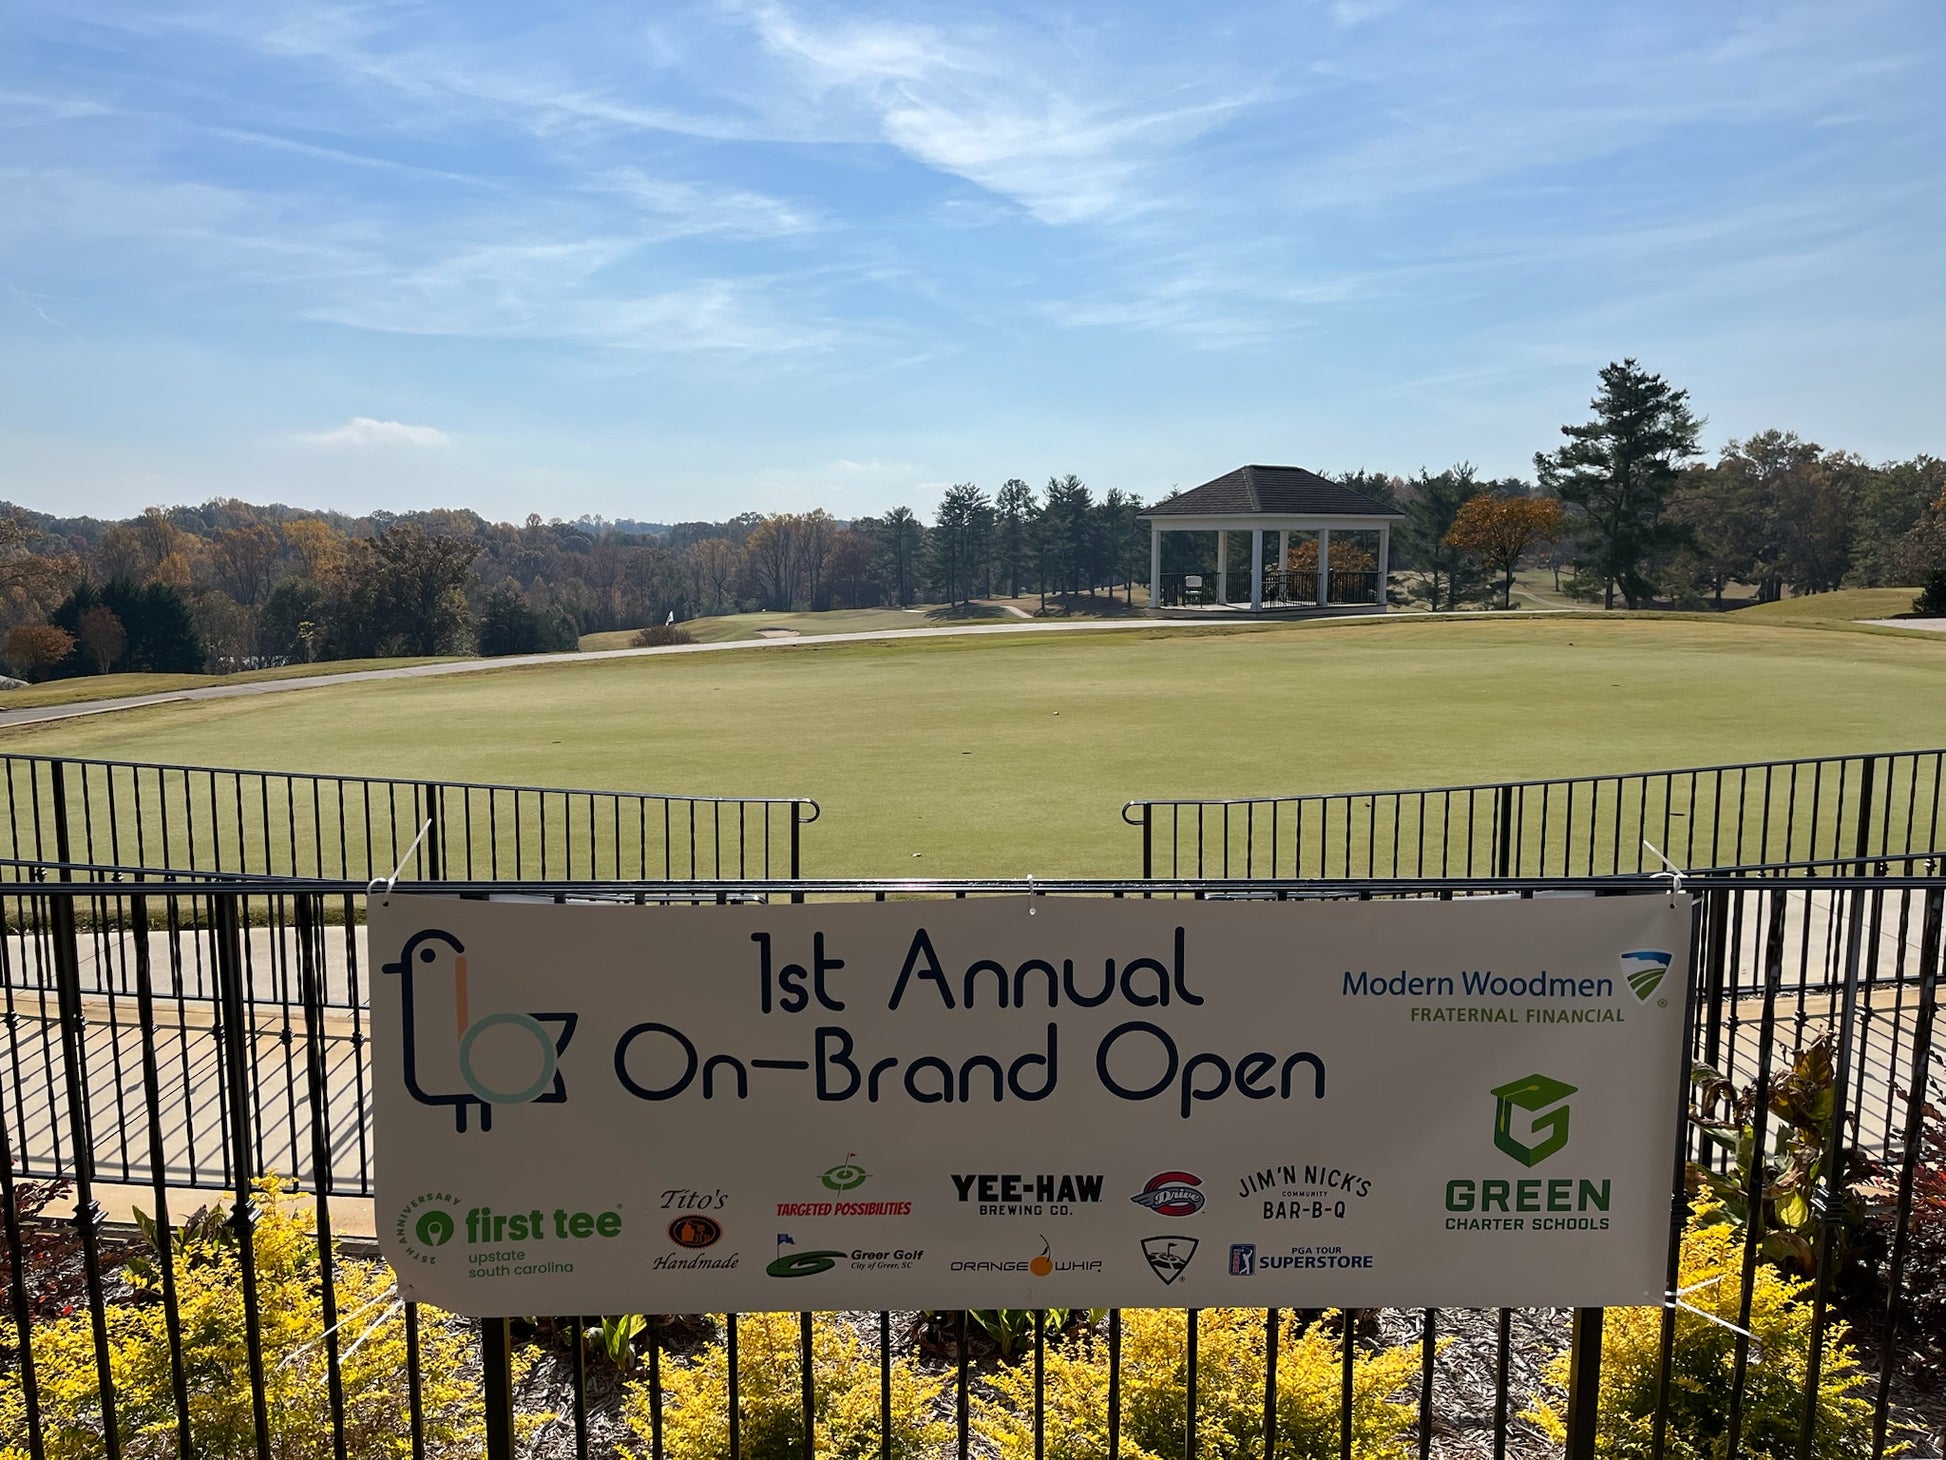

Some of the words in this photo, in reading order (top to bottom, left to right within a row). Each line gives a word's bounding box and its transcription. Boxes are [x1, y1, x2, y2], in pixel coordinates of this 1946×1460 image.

[751, 929, 847, 1015] 1st
[888, 924, 1206, 1011] Annual
[1342, 970, 1454, 997] Modern
[1462, 970, 1614, 998] Woodmen
[1410, 1007, 1519, 1024] FRATERNAL
[1525, 1008, 1626, 1024] FINANCIAL
[1096, 1020, 1327, 1120] Open
[950, 1174, 1103, 1203] YEE-HAW
[1304, 1164, 1373, 1198] NICK'S
[659, 1188, 730, 1210] Tito's
[1154, 1187, 1200, 1207] Drive
[1281, 1190, 1329, 1198] COMMUNITY
[1444, 1179, 1611, 1213] GREEN
[396, 1192, 461, 1244] ANNIVERSARY
[776, 1202, 833, 1217] TARGETED
[834, 1201, 912, 1216] POSSIBILITIES
[979, 1205, 1043, 1216] BREWING
[1049, 1204, 1074, 1216] CO.
[1263, 1201, 1346, 1219] BAR-B-Q
[464, 1205, 545, 1244] first
[552, 1207, 623, 1240] tee
[1445, 1217, 1525, 1231] CHARTER
[1531, 1217, 1610, 1231] SCHOOLS
[468, 1248, 526, 1265] upstate
[651, 1251, 740, 1271] Handmade
[851, 1249, 890, 1260] Greer
[893, 1249, 924, 1260] Golf
[1259, 1256, 1373, 1268] SUPERSTORE
[468, 1264, 510, 1278] south
[513, 1261, 574, 1277] carolina
[851, 1262, 866, 1270] City
[867, 1261, 877, 1270] of
[877, 1261, 900, 1269] Greer,
[901, 1261, 913, 1269] SC
[950, 1261, 1029, 1271] ORANGE
